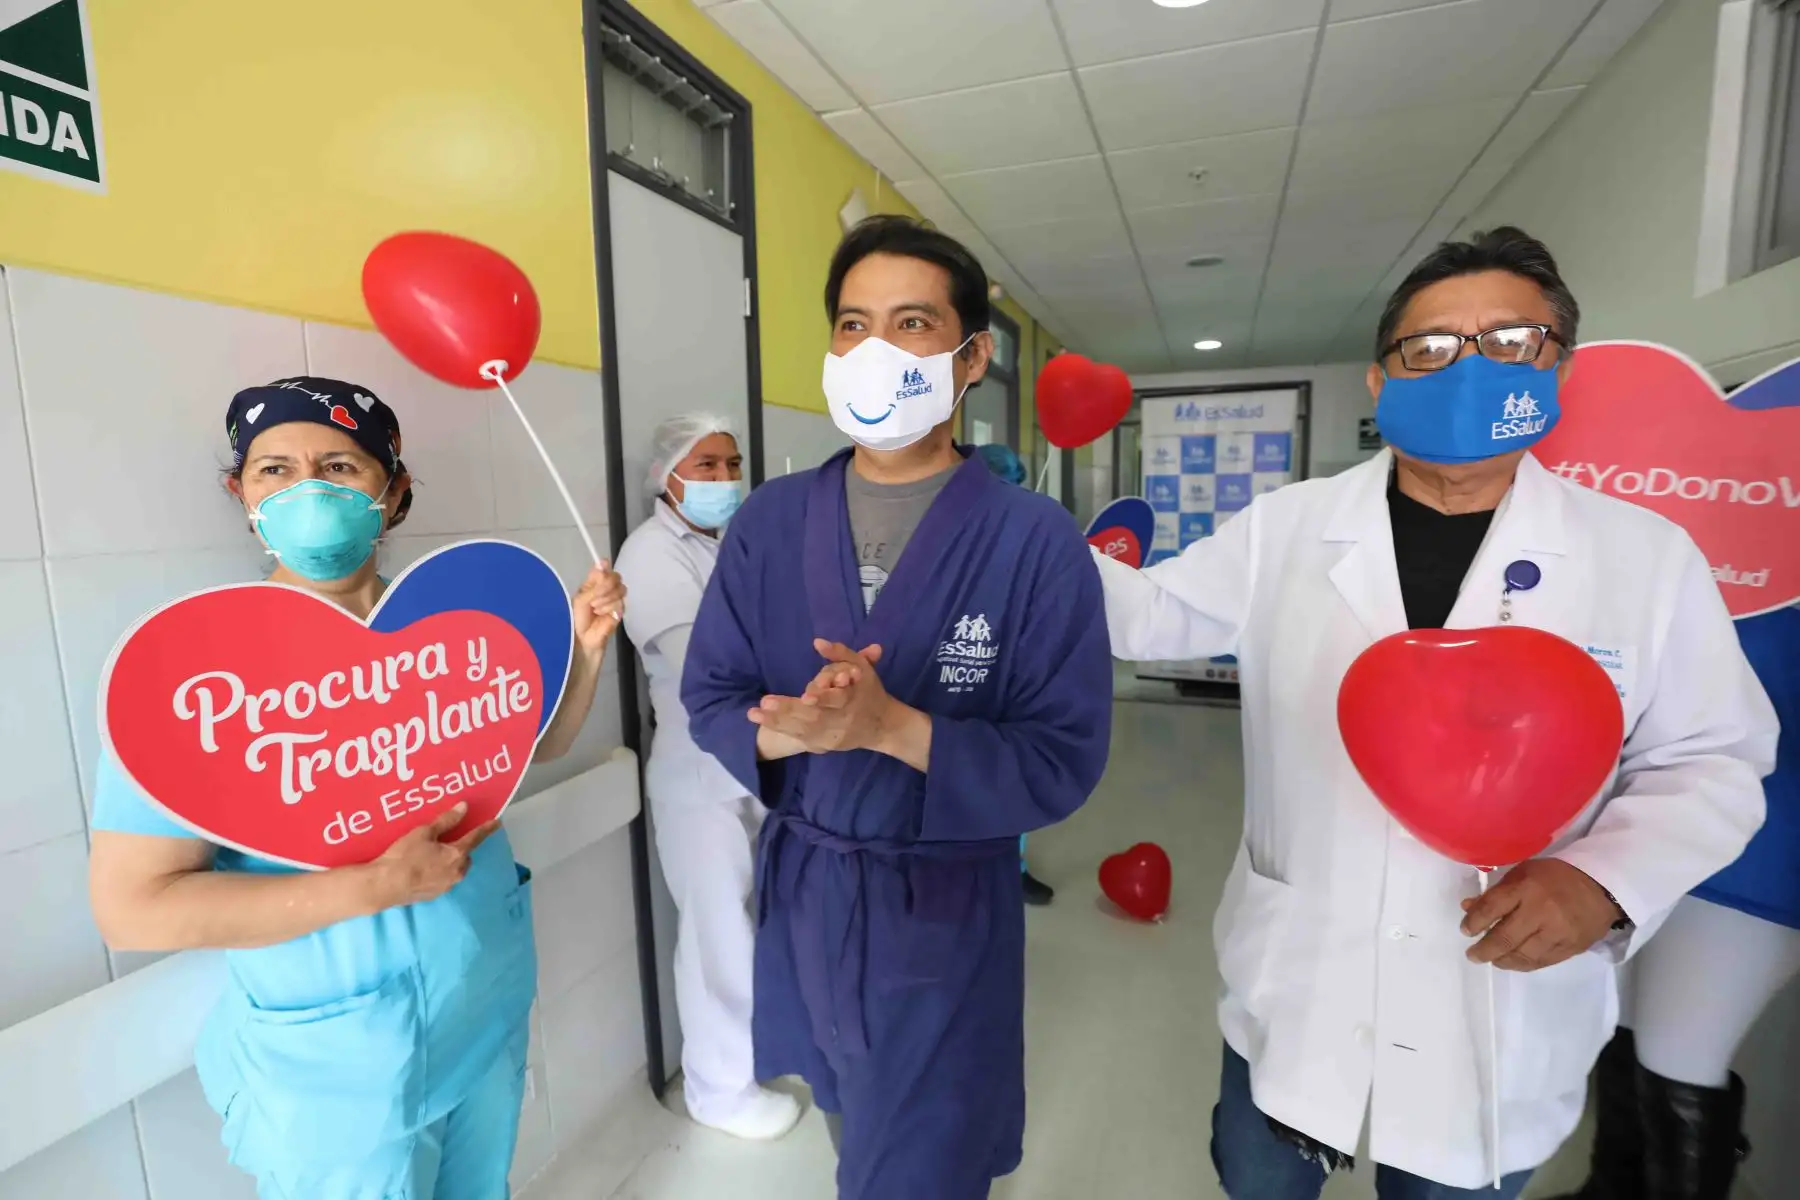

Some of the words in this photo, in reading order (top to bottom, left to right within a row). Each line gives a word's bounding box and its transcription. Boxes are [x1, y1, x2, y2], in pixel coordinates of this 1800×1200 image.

[896, 383, 932, 400] EsSalud
[1205, 404, 1264, 420] EsSalud
[1492, 414, 1548, 440] EsSalud
[938, 641, 1000, 659] EsSalud
[939, 665, 989, 683] INCOR
[172, 637, 449, 754] Procura
[466, 636, 488, 682] y
[244, 666, 533, 805] Trasplante
[322, 807, 373, 845] de
[379, 744, 512, 823] EsSalud
